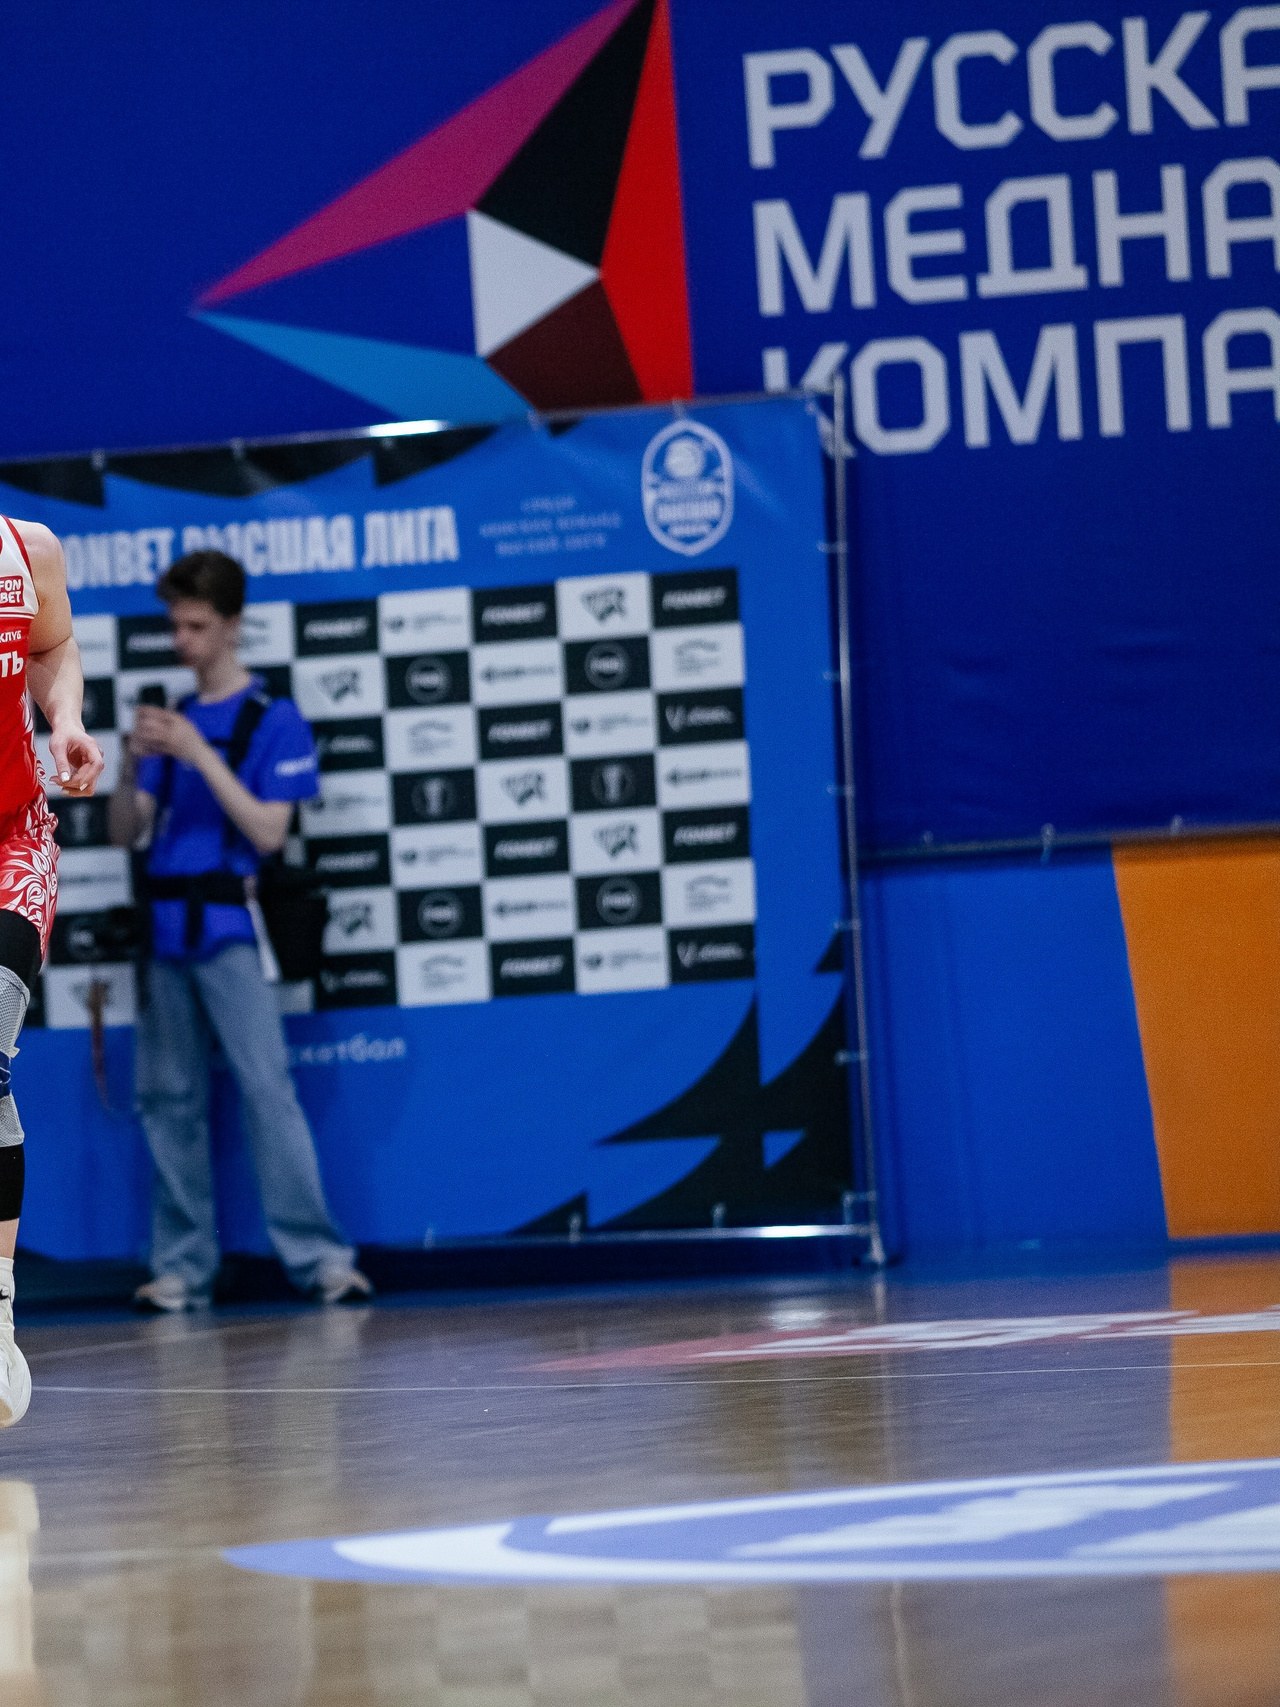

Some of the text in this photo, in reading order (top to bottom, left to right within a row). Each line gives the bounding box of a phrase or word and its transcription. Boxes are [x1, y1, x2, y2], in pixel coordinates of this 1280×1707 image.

[742, 4, 1280, 169] РУССКА
[752, 156, 1280, 318] МЕДНА
[0, 591, 22, 606] BET
[65, 526, 176, 591] ONBET
[362, 505, 461, 570] ЛИГА
